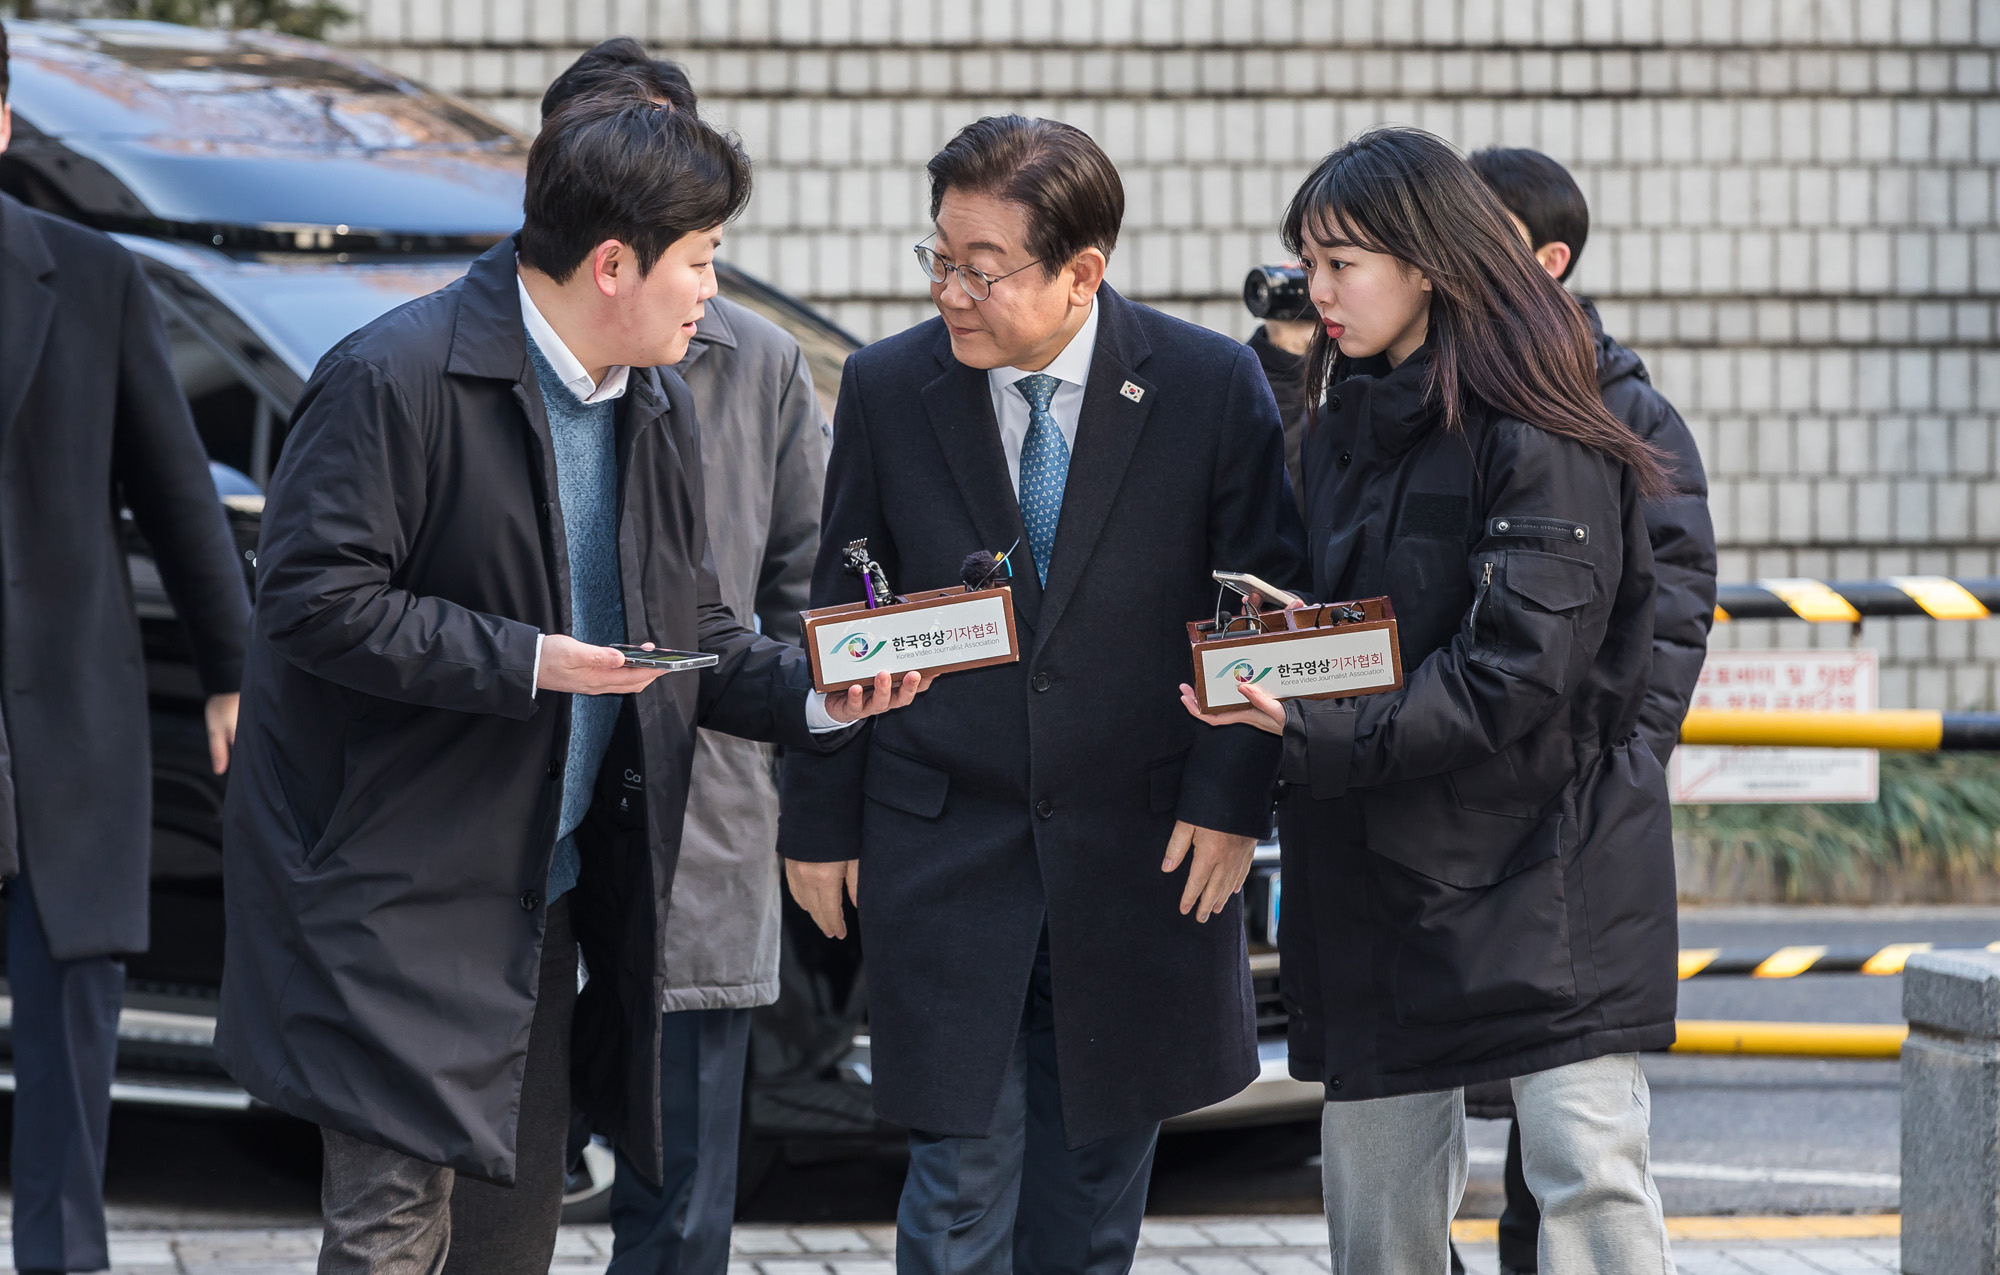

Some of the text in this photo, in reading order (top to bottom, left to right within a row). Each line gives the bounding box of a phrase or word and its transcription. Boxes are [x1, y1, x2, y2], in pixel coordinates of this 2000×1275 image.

[892, 622, 999, 651] 한국영상기자협회
[896, 639, 1000, 660] Korea Video Journalist Association
[1277, 652, 1384, 678] 한국영상기자협회
[1280, 668, 1385, 686] Korea Video Journalist Association
